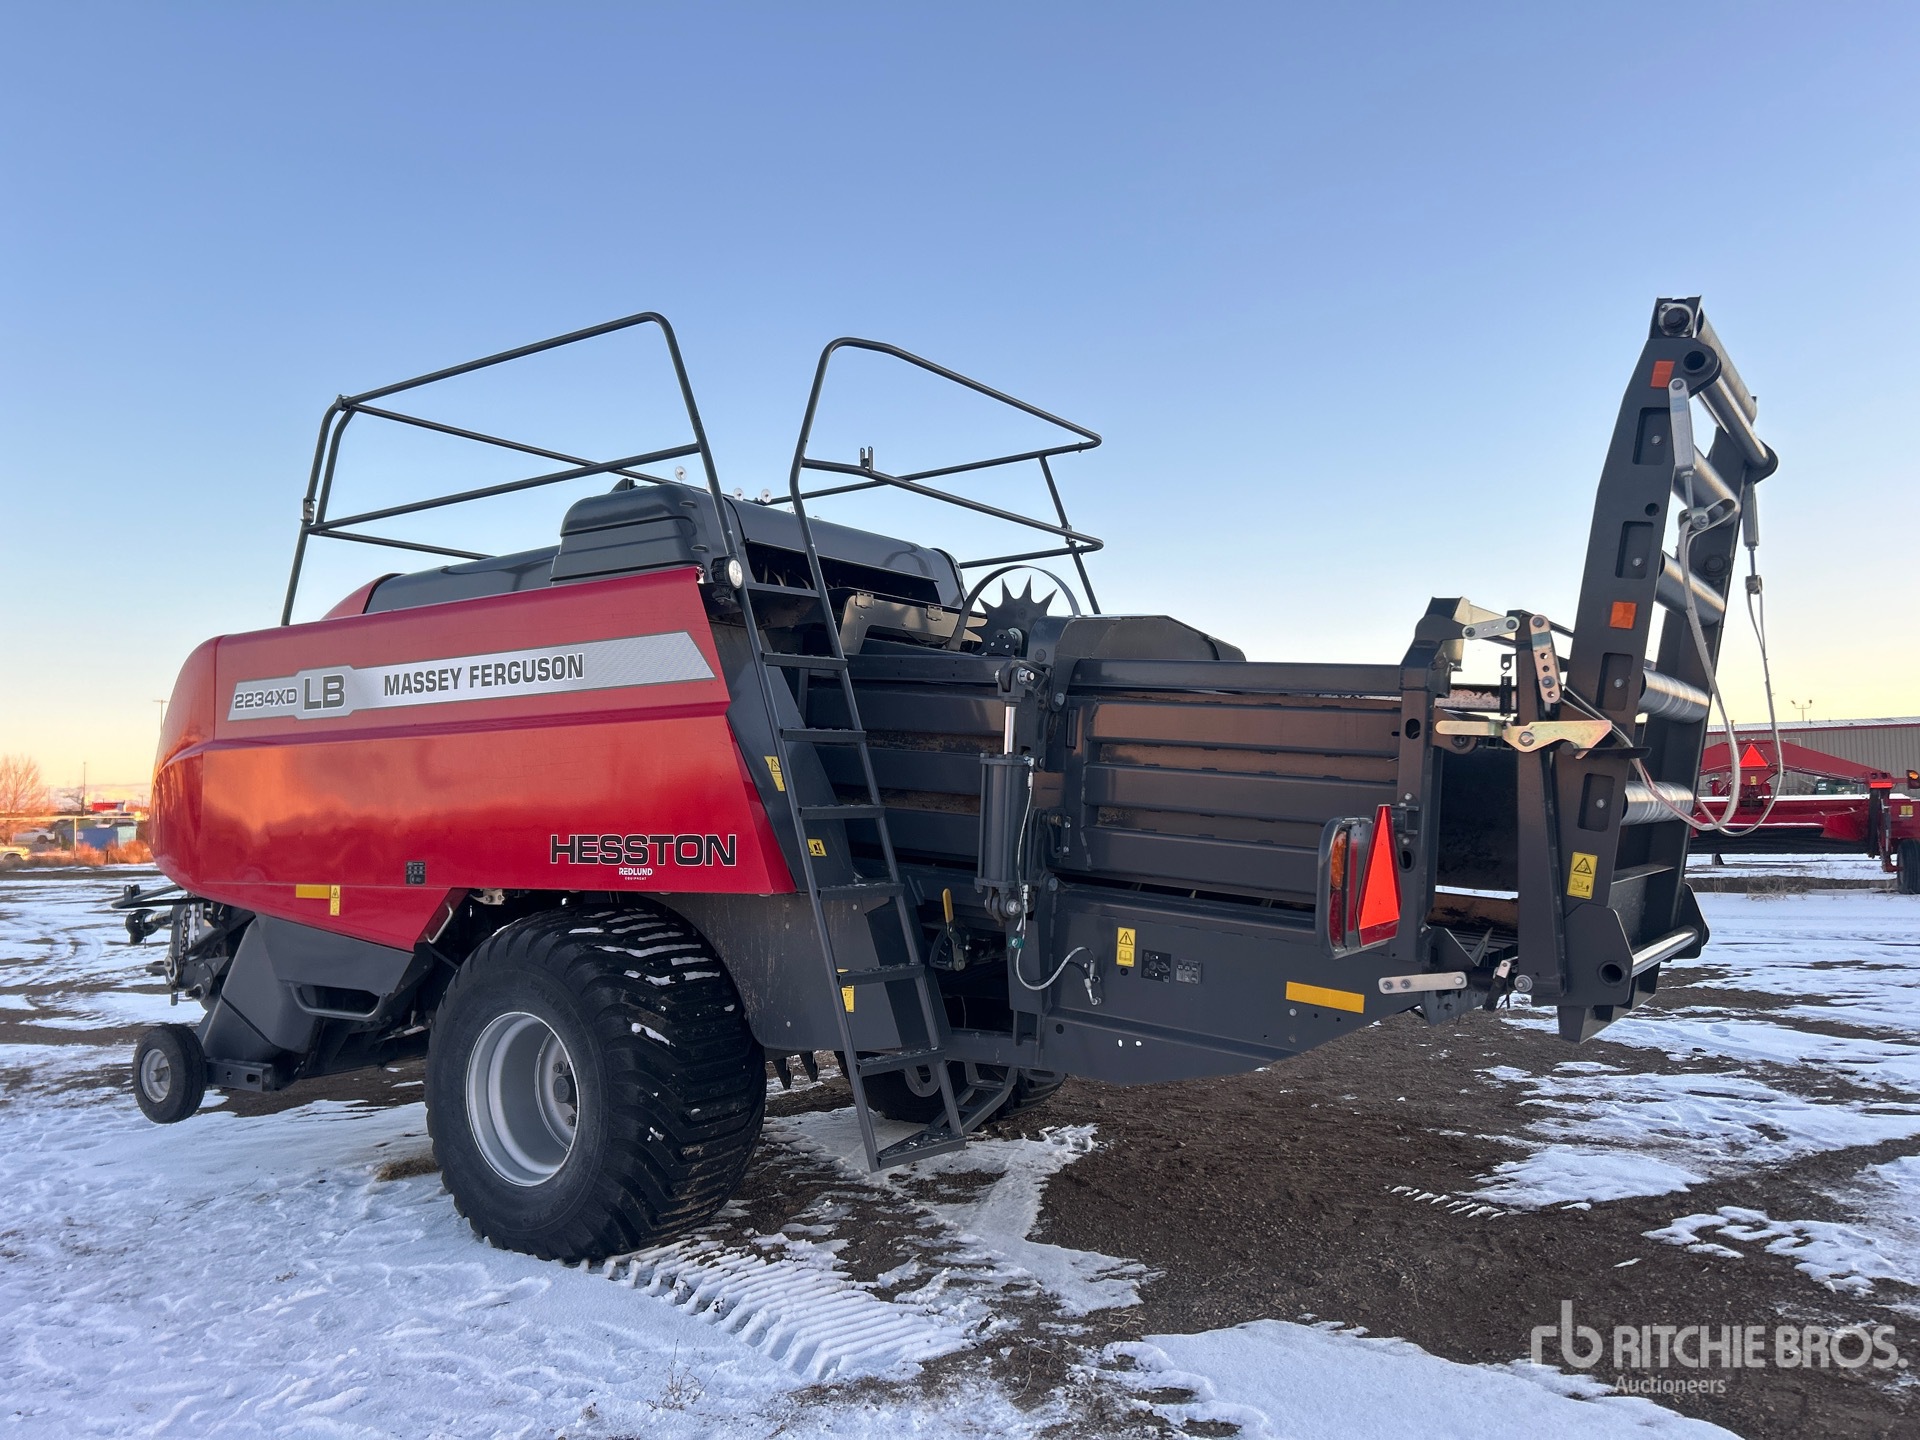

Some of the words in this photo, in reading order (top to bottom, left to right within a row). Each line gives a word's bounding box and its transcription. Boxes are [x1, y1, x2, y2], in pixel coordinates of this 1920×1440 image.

[234, 687, 298, 709] 2234XD
[303, 674, 345, 710] LB
[384, 667, 462, 696] MASSEY
[469, 654, 584, 688] FERGUSON
[550, 834, 737, 866] HESSTON
[618, 867, 653, 876] REDLUND
